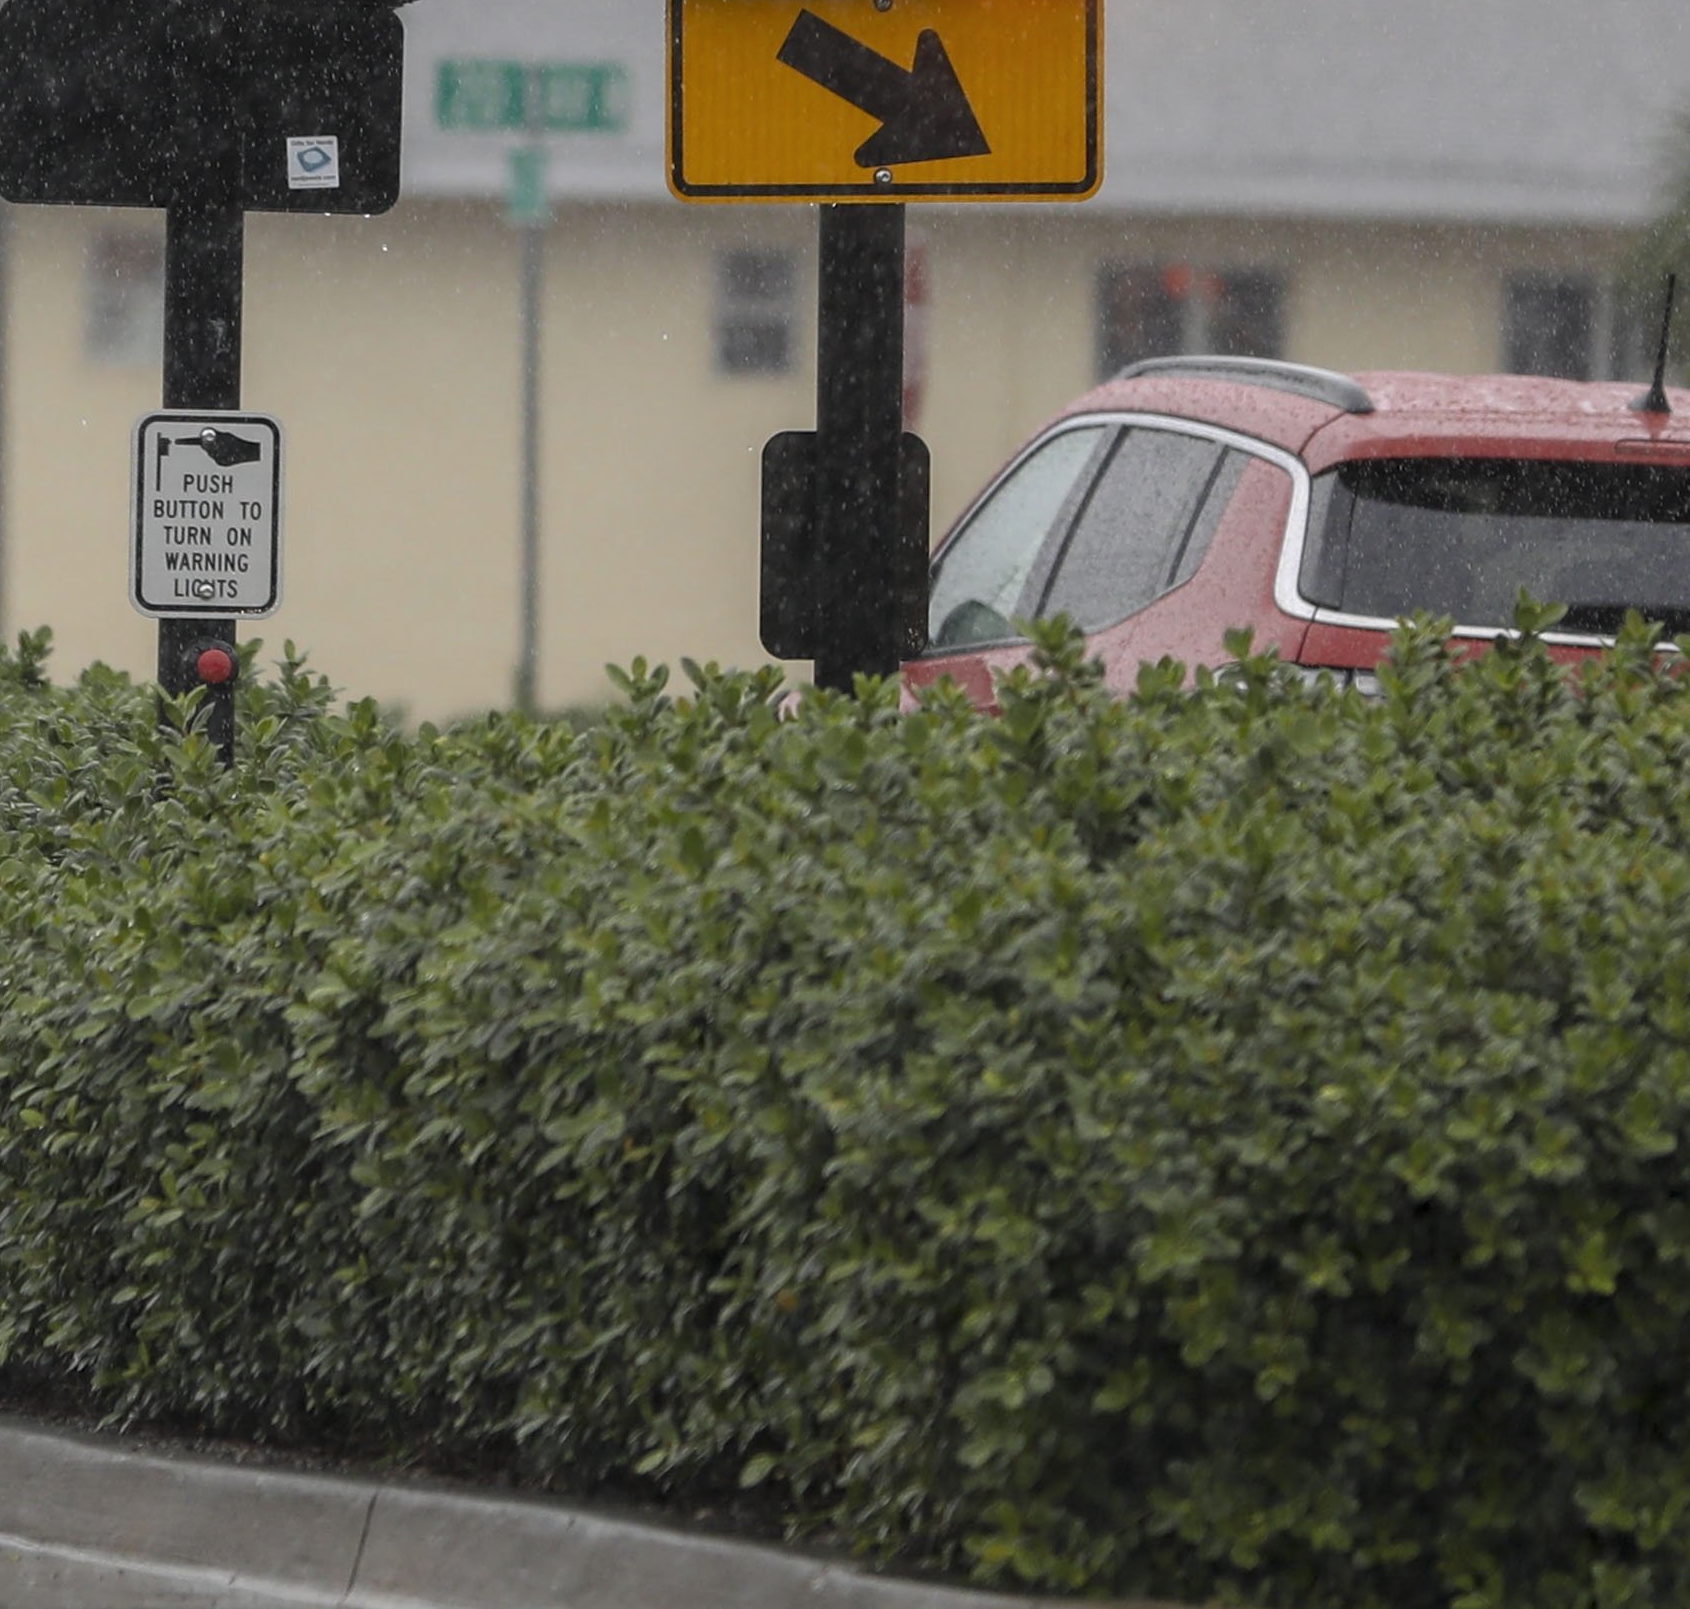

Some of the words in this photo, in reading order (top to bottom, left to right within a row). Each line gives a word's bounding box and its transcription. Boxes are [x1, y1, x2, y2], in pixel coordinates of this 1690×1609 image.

[183, 474, 234, 494] PUSH
[153, 499, 224, 520] BUTTON
[240, 501, 262, 521] TO
[164, 526, 212, 546] TURN
[226, 527, 252, 547] ON
[165, 552, 249, 573] WARNING
